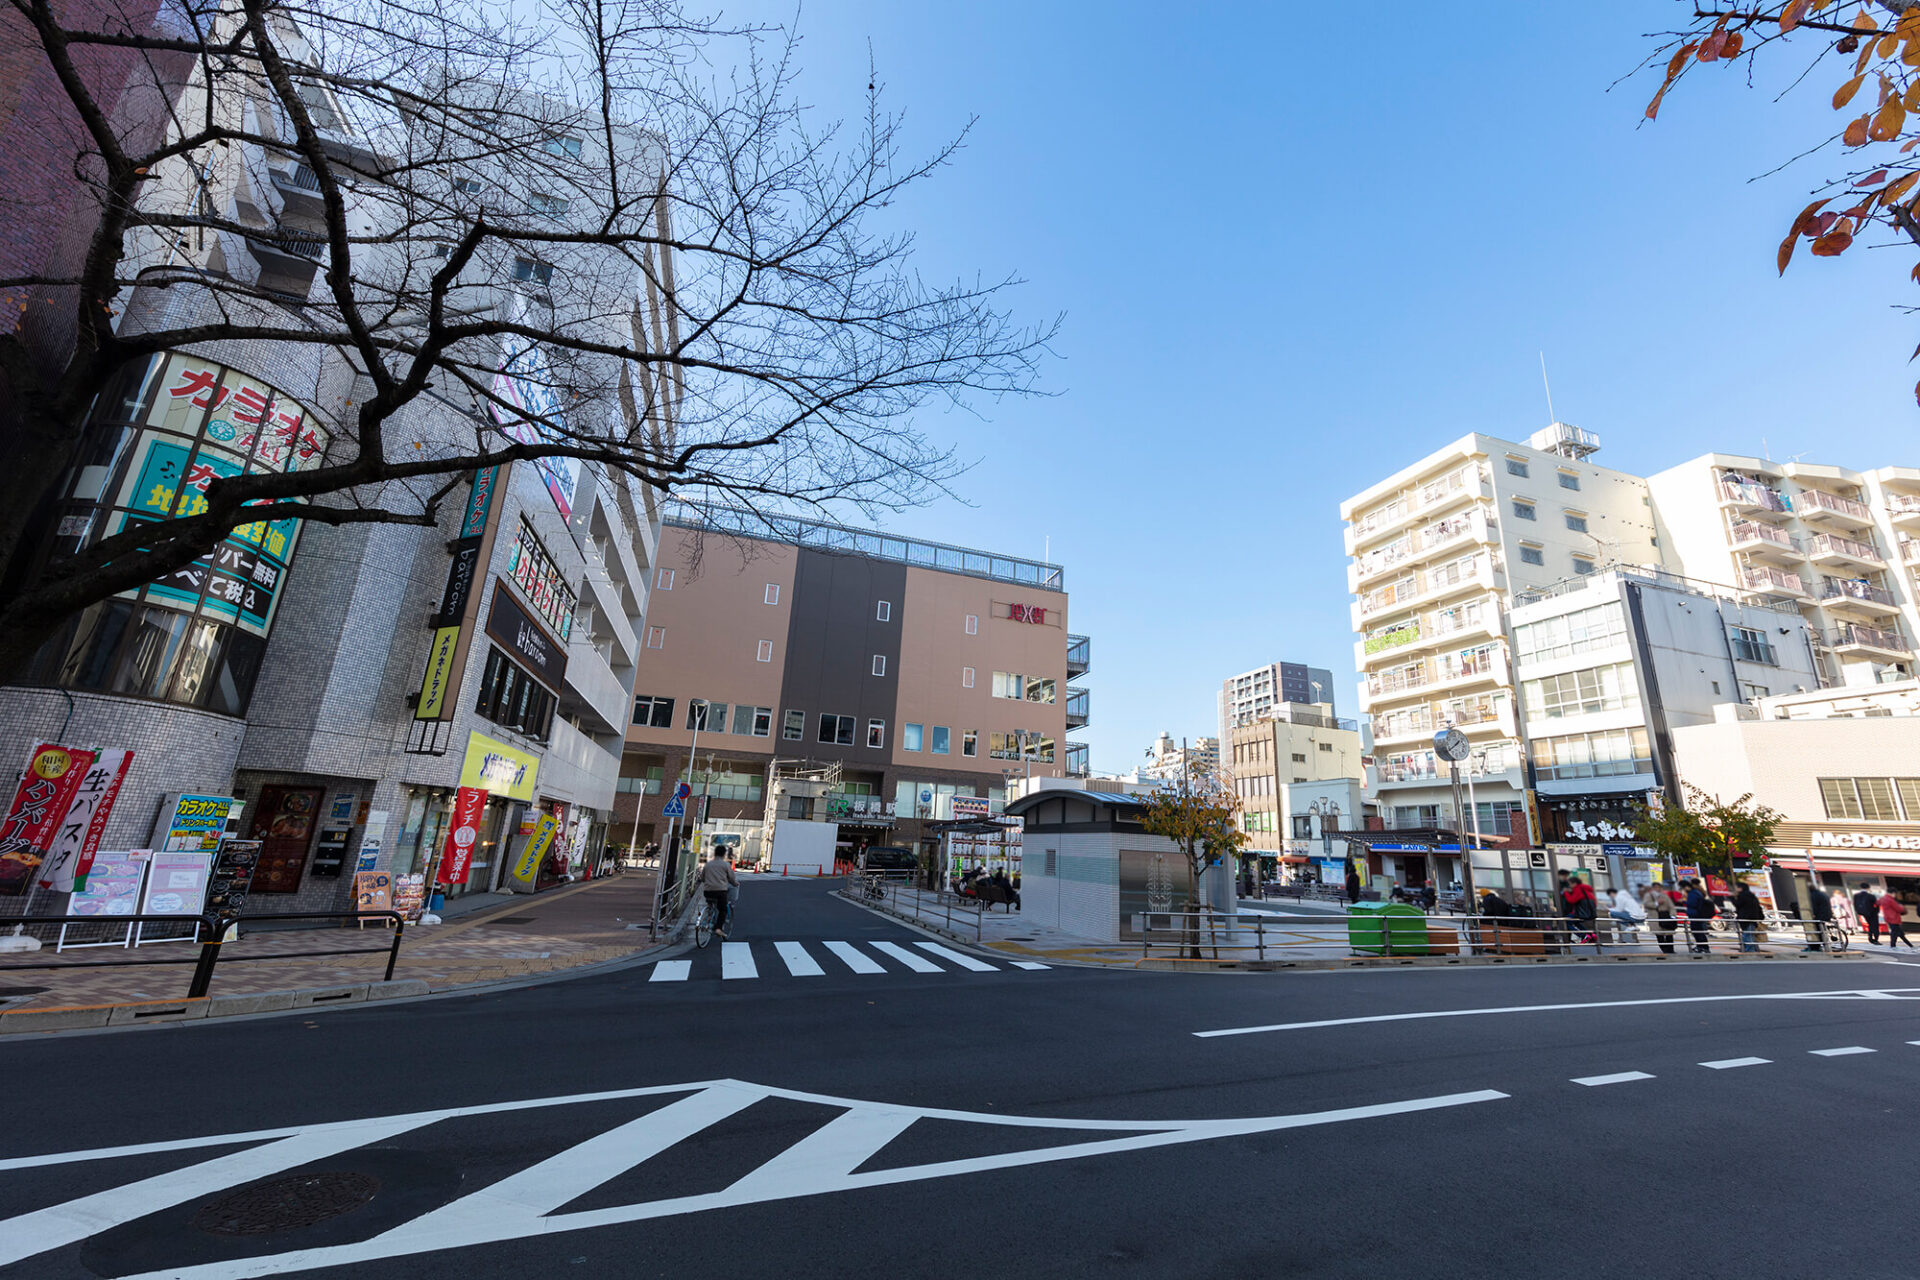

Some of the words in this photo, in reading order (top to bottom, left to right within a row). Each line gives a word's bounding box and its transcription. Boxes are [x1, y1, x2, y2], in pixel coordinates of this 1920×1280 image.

[169, 370, 321, 459] カラオケ
[239, 432, 281, 465] ALL
[470, 465, 494, 524] カラオケ
[156, 569, 257, 610] べて税込
[447, 547, 476, 617] baroom
[426, 634, 452, 709] メガネドラッグ
[0, 779, 57, 856] ハンバーグ
[54, 768, 110, 871] 生パスタ
[176, 798, 217, 816] カラオケ
[216, 801, 229, 810] ALL
[463, 791, 479, 825] ランチ
[827, 800, 849, 813] JR
[449, 848, 468, 883] 営業中
